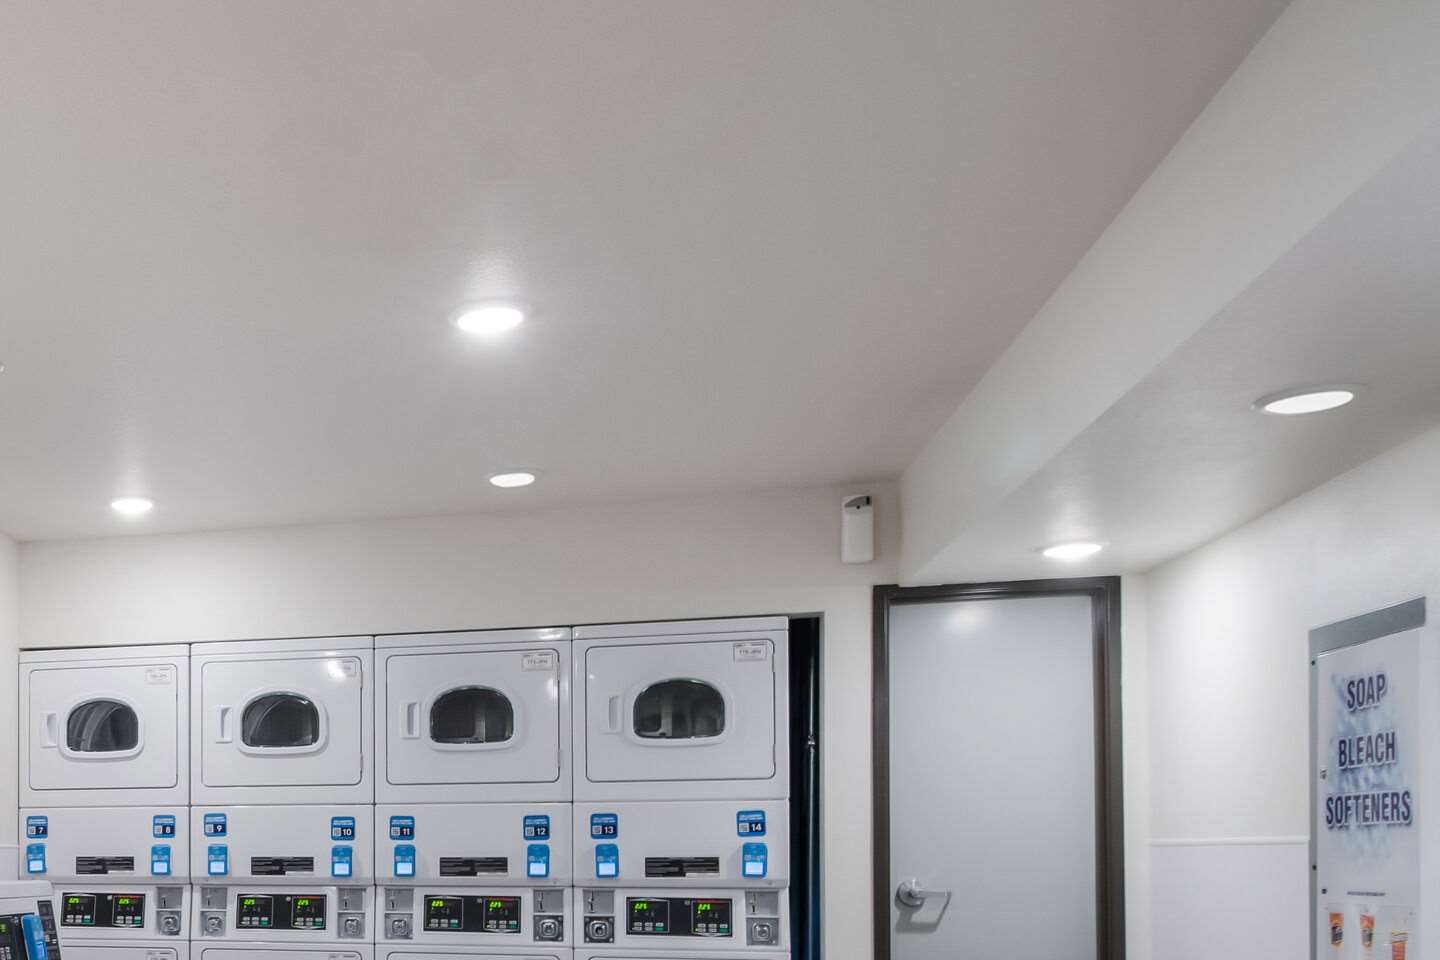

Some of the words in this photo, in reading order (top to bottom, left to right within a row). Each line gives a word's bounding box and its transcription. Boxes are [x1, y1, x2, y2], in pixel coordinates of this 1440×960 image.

[1346, 673, 1386, 709] SOAP
[1338, 731, 1396, 768] BLEACH
[1326, 790, 1411, 825] SOFTENERS
[38, 826, 44, 834] 7
[216, 824, 223, 832] 9
[536, 827, 546, 836] 12
[604, 826, 614, 834] 13
[751, 823, 762, 832] 14
[342, 828, 352, 836] 10
[402, 828, 411, 836] 11
